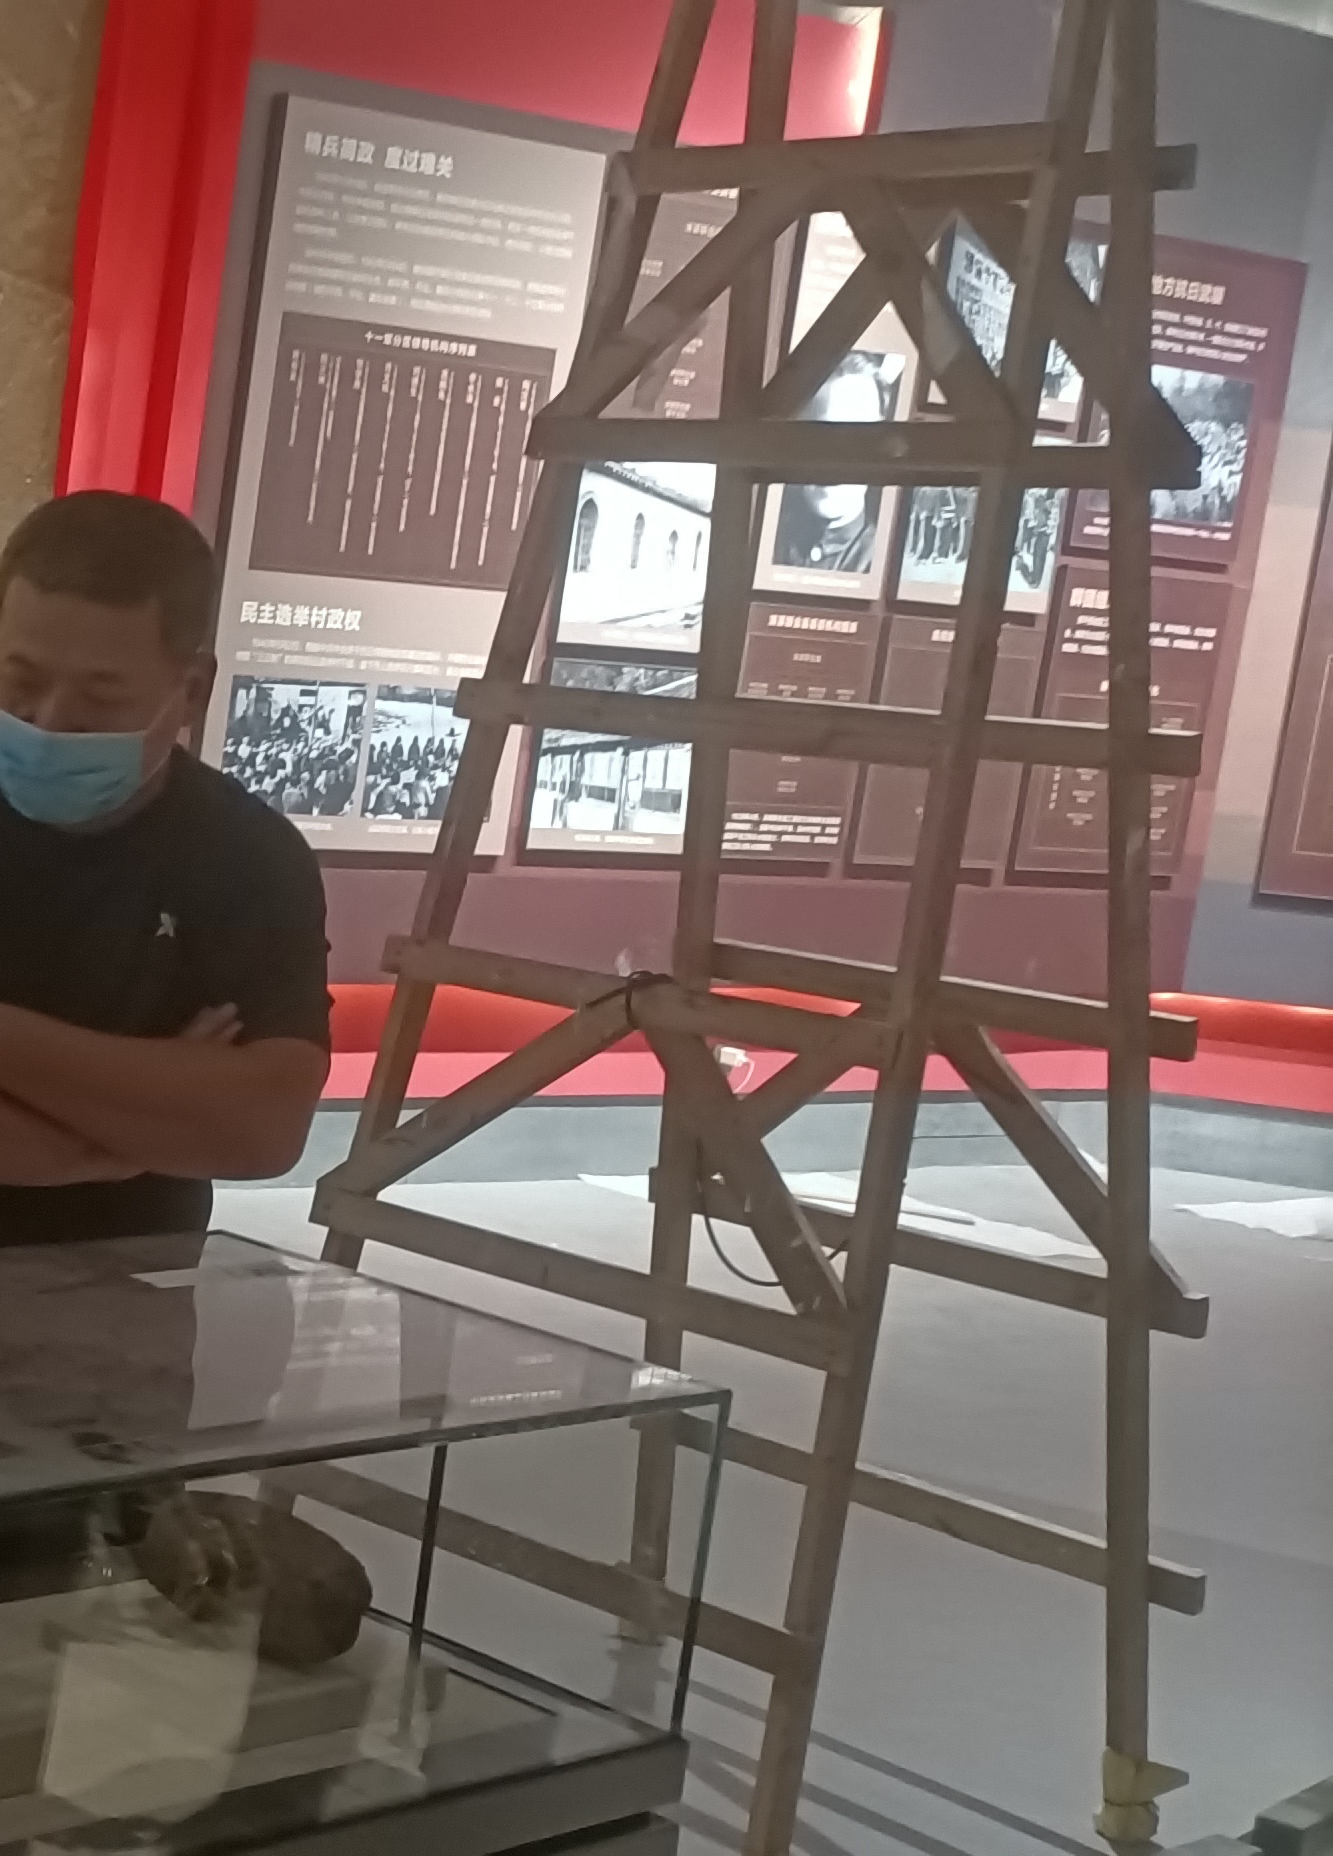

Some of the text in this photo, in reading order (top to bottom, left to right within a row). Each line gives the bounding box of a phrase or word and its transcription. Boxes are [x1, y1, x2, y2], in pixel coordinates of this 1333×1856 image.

[240, 600, 362, 631] 民主选举村政权
